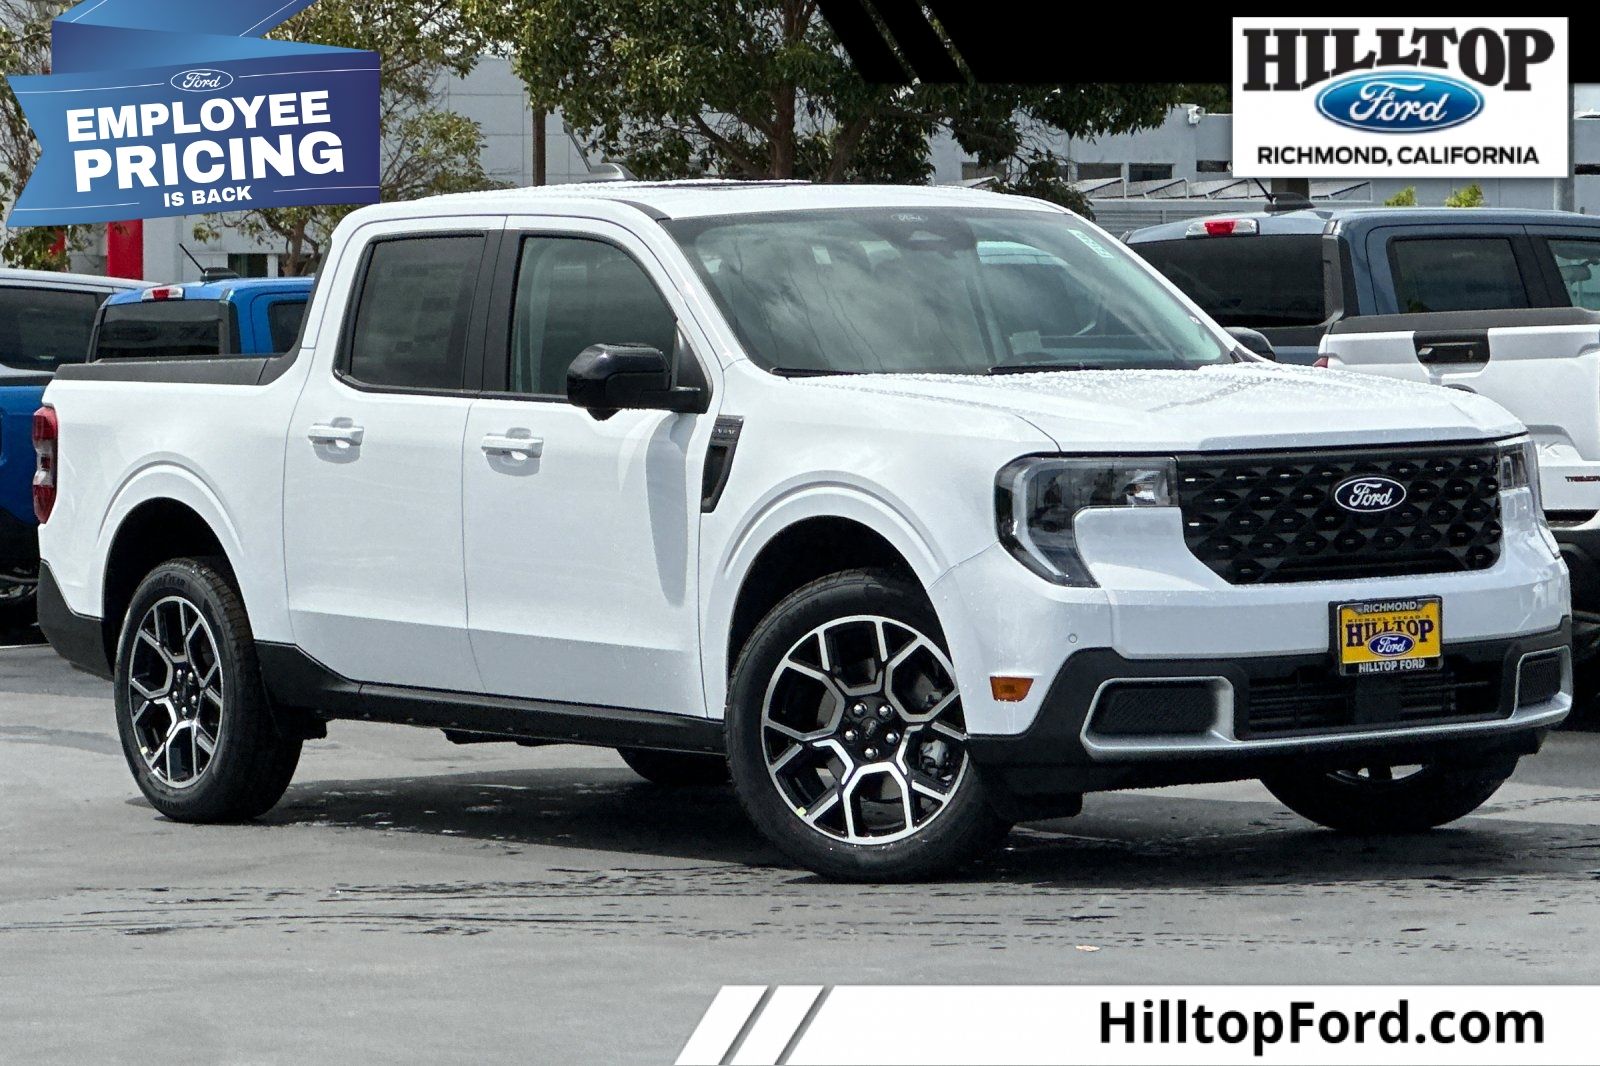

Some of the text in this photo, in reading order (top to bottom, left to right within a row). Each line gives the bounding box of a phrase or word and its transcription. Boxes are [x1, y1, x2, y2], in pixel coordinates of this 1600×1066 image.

[1348, 482, 1394, 507] Ford
[1363, 601, 1417, 613] RICHMOND
[1346, 620, 1434, 647] HILLTOP
[1377, 637, 1405, 653] Ford
[1359, 659, 1425, 673] HILLTOP FORD
